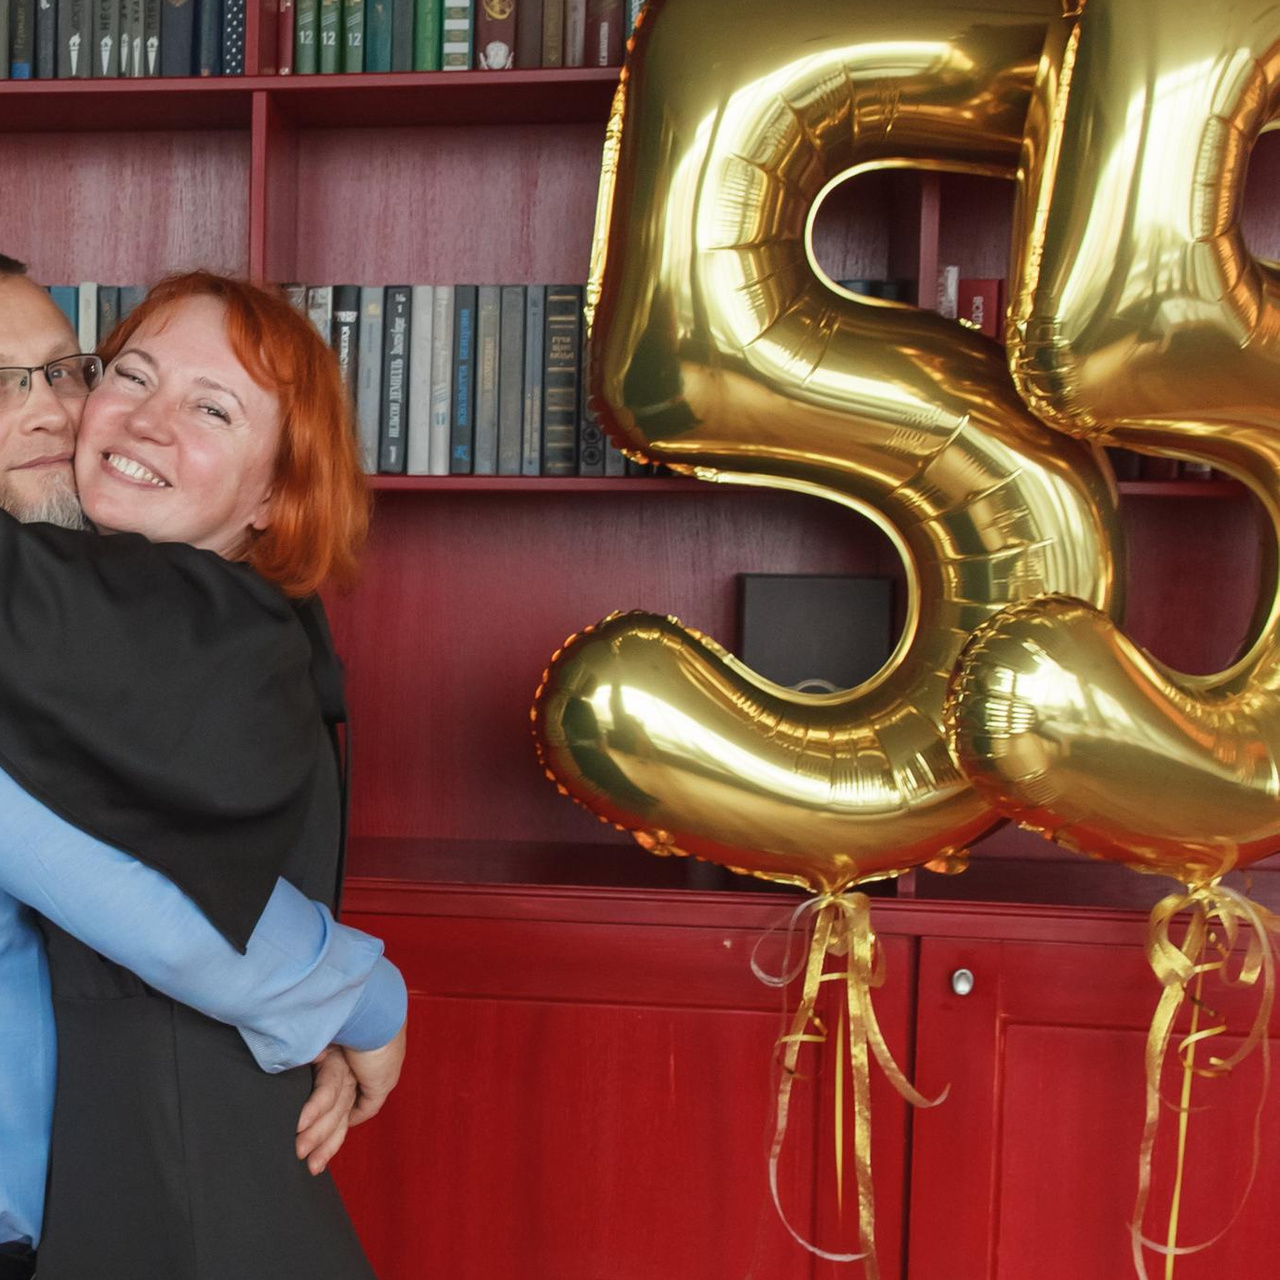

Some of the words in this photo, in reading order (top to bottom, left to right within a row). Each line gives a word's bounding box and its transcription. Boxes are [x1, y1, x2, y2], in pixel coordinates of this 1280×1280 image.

[14, 7, 25, 50] Герман
[299, 30, 313, 44] 12
[322, 31, 336, 45] 12
[348, 32, 361, 46] 12
[459, 309, 471, 360] БЕНЦОНИ
[457, 365, 469, 426] ЖЮЛЬЕТТА
